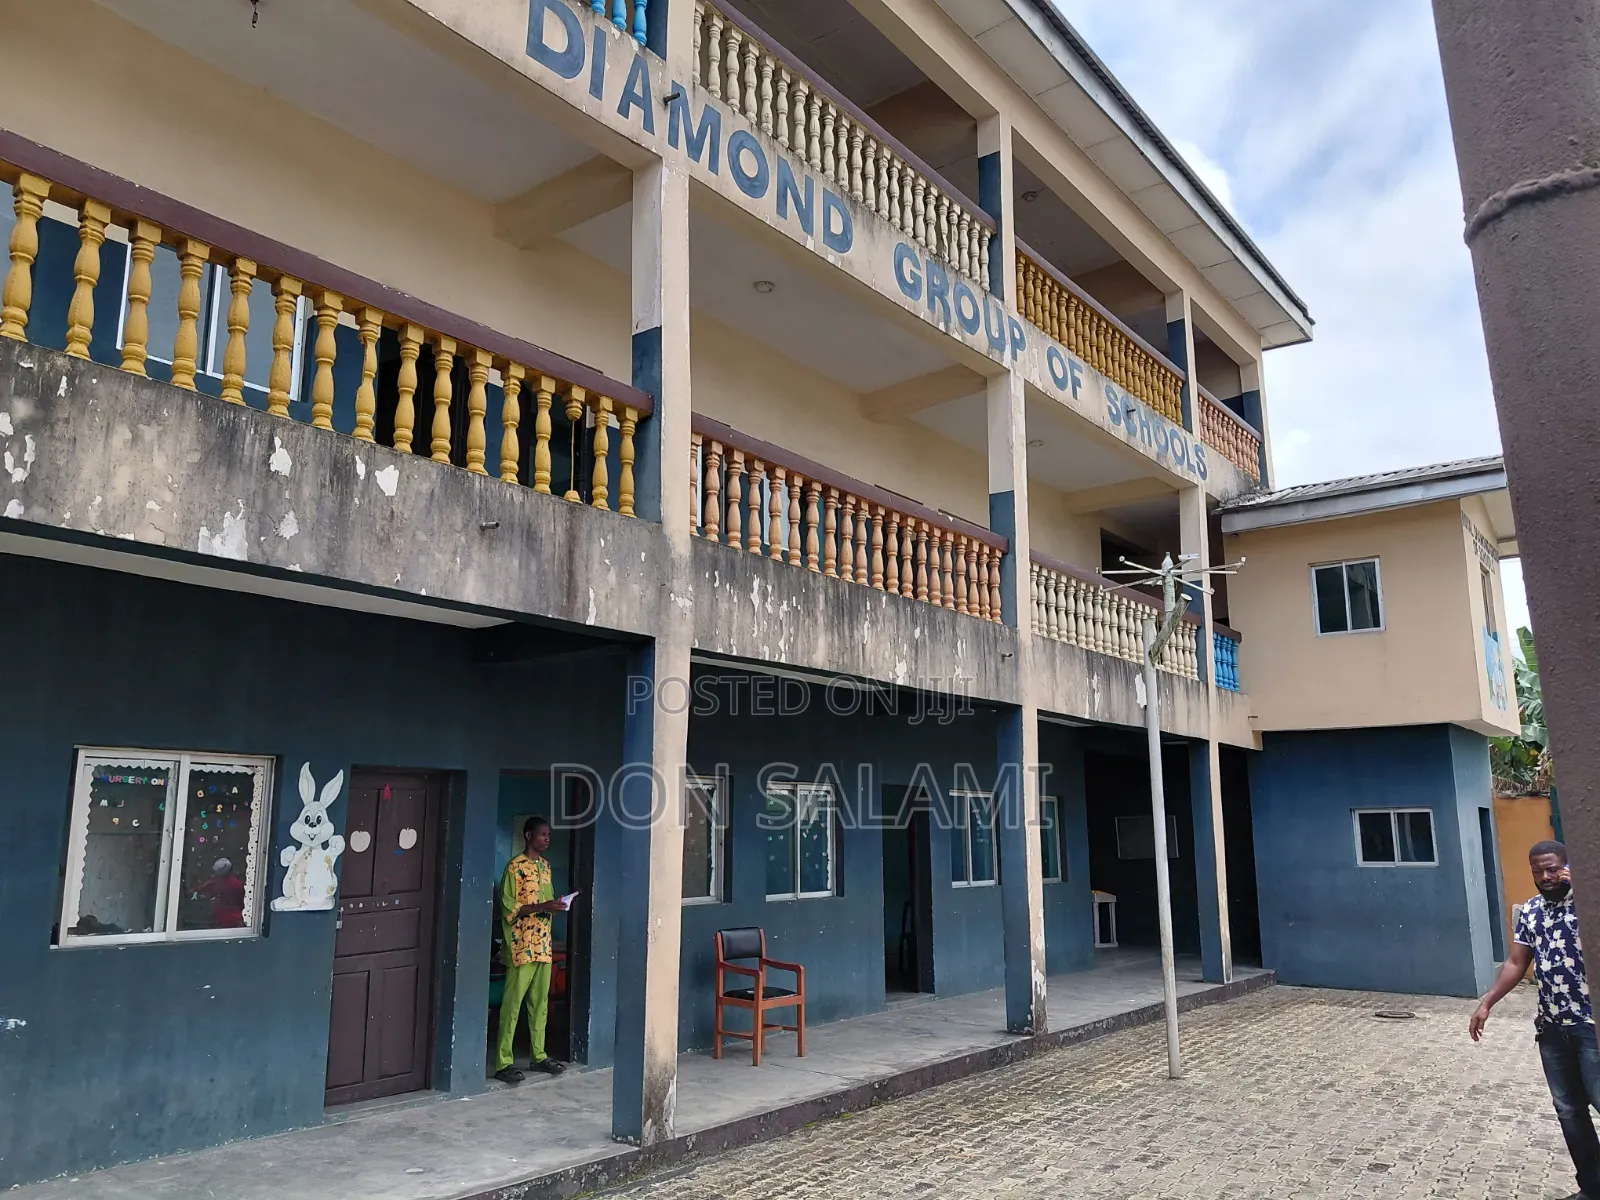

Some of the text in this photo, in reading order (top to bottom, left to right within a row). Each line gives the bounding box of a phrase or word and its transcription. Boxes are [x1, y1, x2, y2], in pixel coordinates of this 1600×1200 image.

[525, 0, 1208, 482] DIAMOND GROUP OF SCHOOLS
